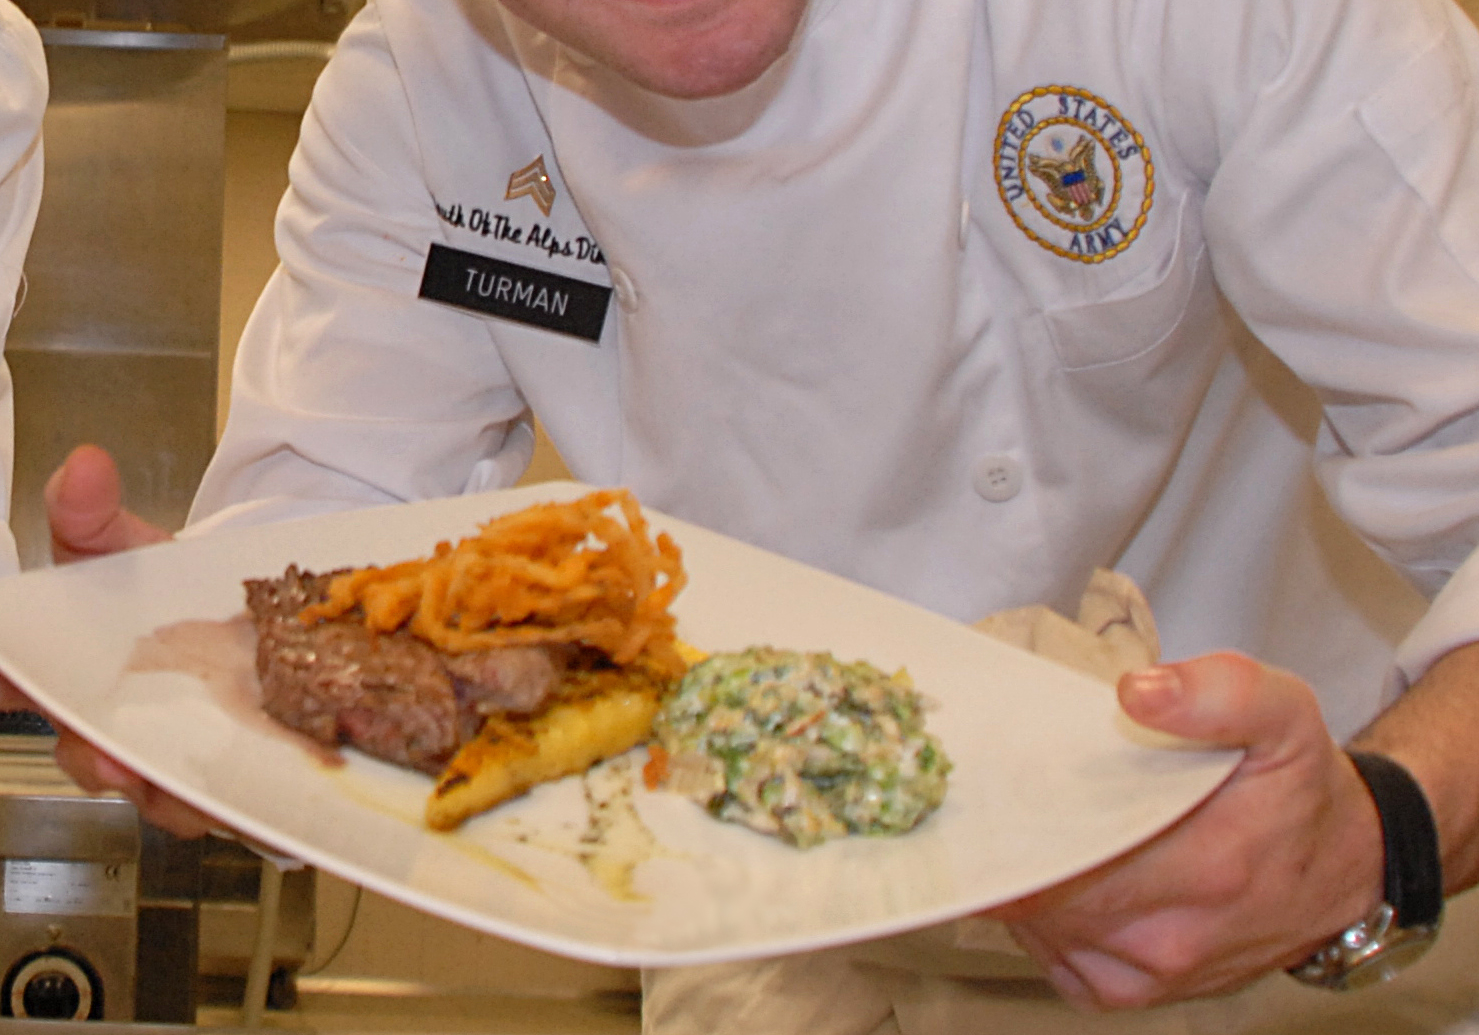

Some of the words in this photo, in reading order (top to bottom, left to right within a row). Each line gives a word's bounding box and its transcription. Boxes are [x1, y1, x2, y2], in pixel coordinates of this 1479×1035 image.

[999, 108, 1035, 202] UNITED
[1058, 95, 1139, 160] STATES
[494, 215, 522, 244] The
[525, 223, 573, 258] Alps
[1070, 218, 1129, 254] ARMY
[466, 269, 569, 316] TURMAN
